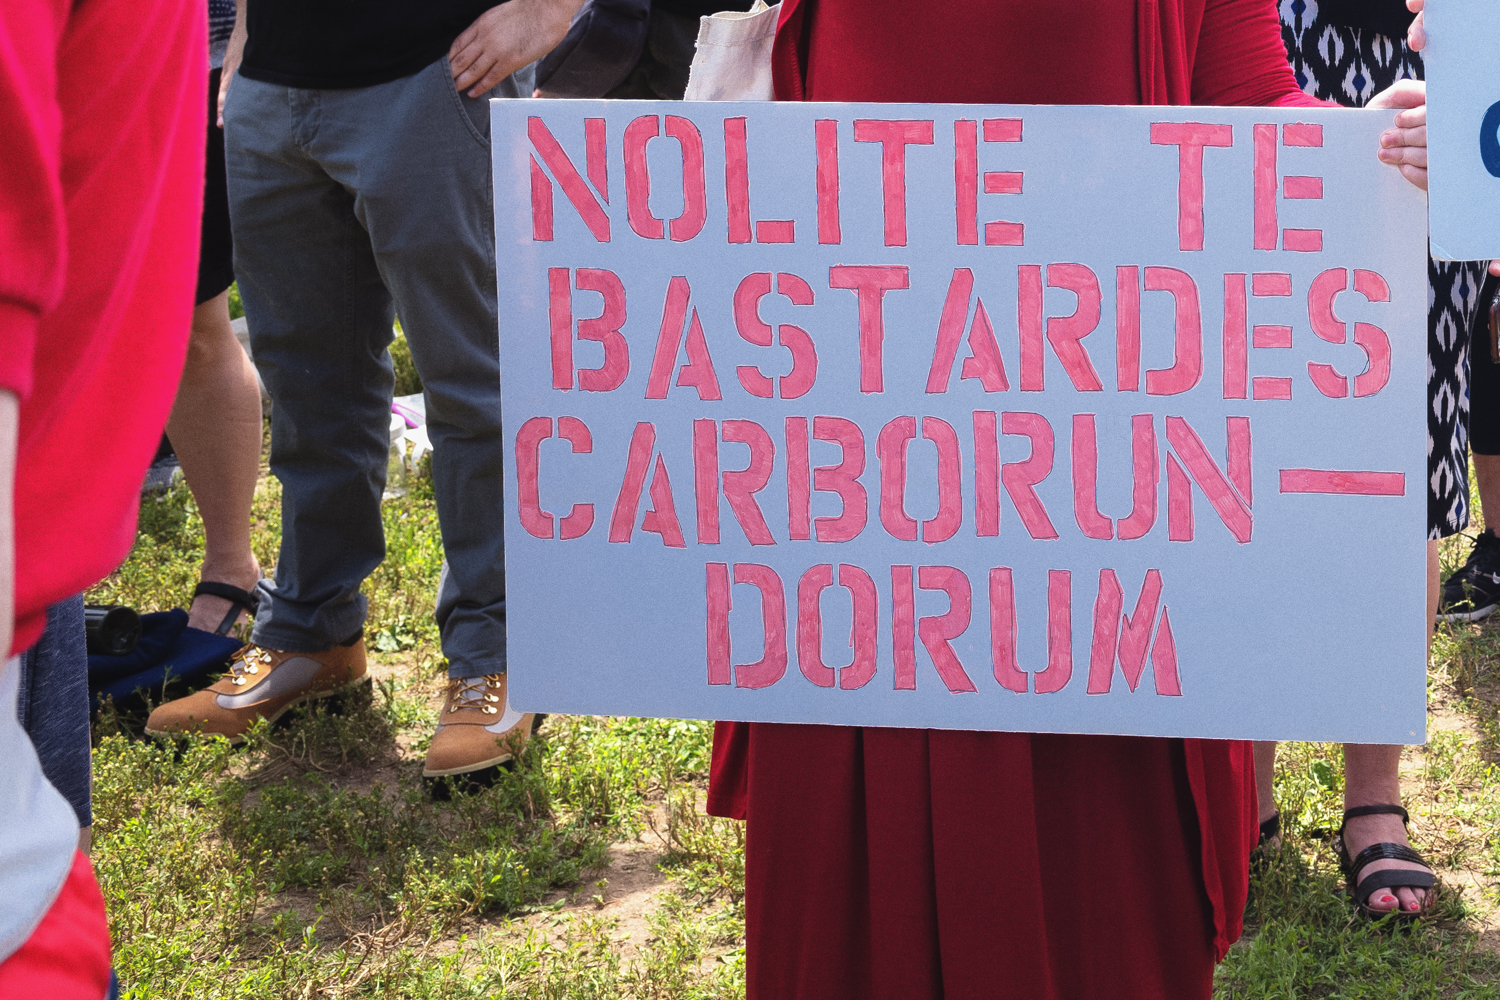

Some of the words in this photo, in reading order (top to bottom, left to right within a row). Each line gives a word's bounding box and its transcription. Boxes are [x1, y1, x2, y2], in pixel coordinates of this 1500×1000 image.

[527, 114, 1025, 247] NOLITE
[1149, 121, 1325, 252] TE
[547, 262, 1392, 401] BASTARDES
[705, 562, 1184, 697] DORUM
